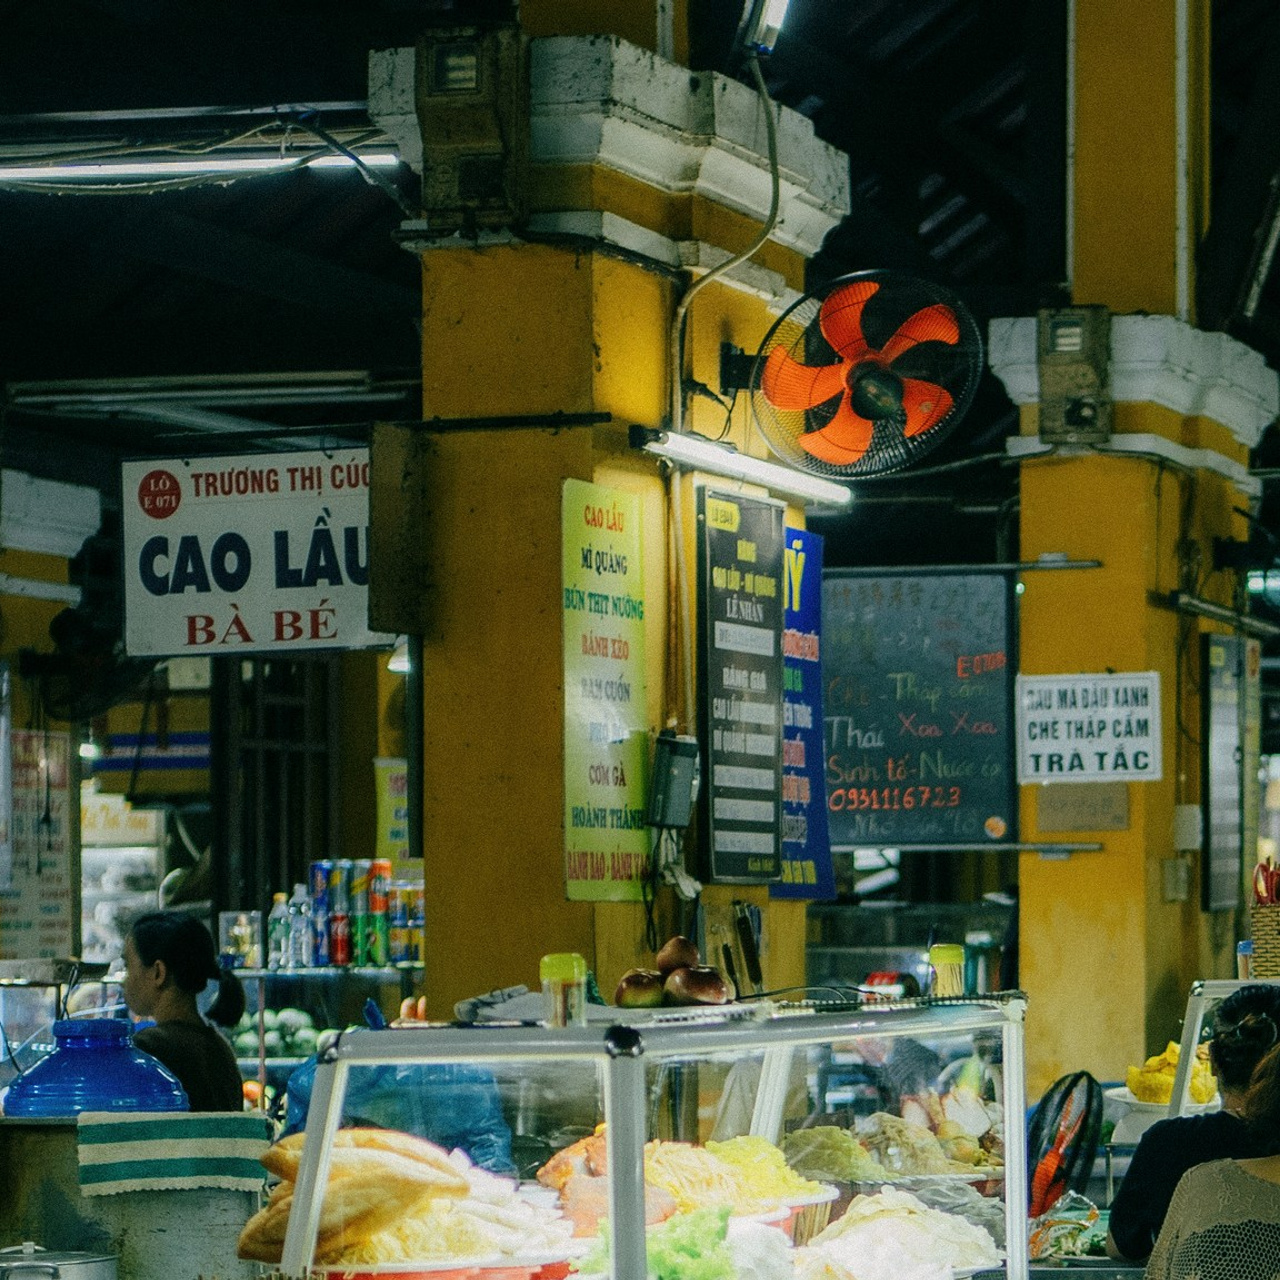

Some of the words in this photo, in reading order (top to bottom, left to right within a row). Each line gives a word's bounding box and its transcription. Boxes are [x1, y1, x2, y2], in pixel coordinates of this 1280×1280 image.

[191, 466, 279, 498] TRƯƠNG
[287, 464, 323, 496] THỊ
[139, 531, 252, 596] CAO
[274, 507, 369, 589] LẦU
[183, 603, 254, 646] BÀ
[273, 599, 338, 642] BÉ
[1029, 747, 1085, 773] TRÀ
[1094, 742, 1149, 772] TẮC
